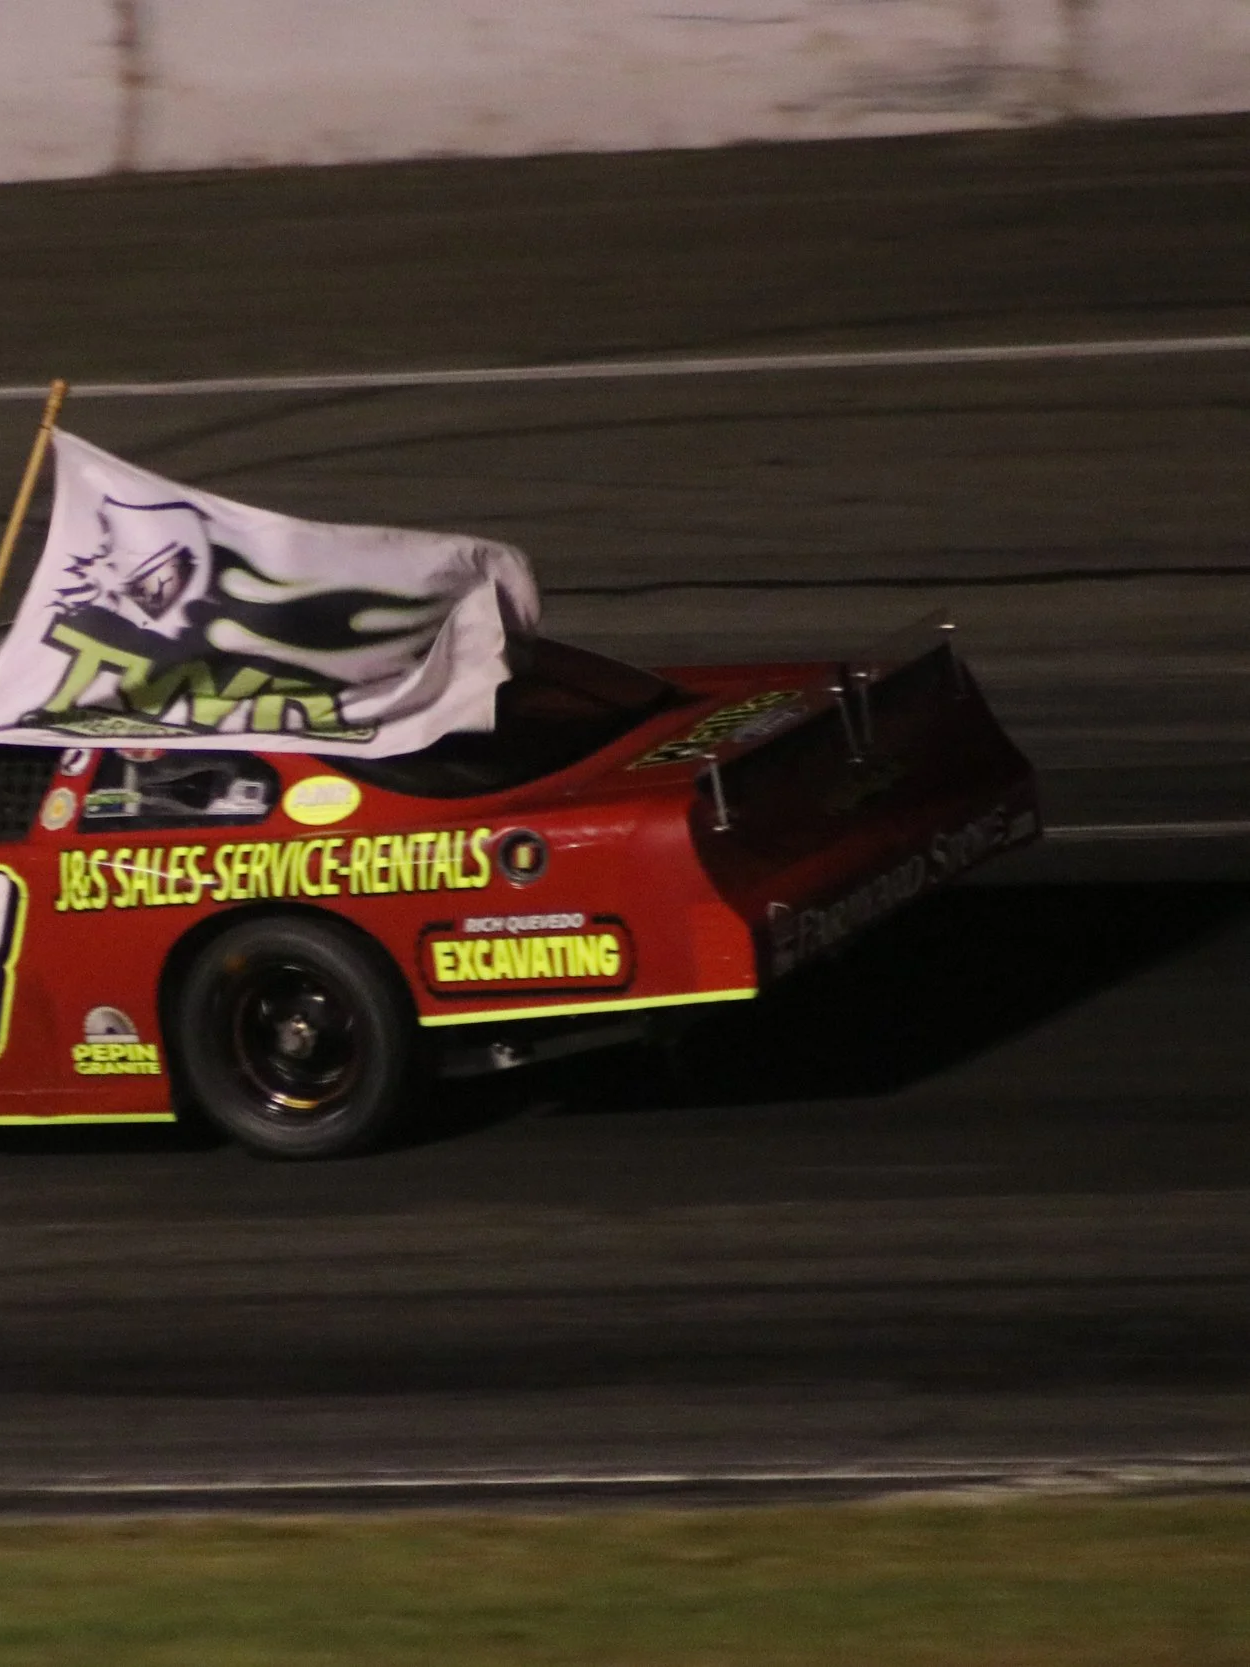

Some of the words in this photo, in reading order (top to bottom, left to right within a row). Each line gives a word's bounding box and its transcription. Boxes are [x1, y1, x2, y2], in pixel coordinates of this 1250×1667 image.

[55, 849, 109, 912] J&S
[112, 828, 492, 906] SALES-SERVICE-RENTALS
[463, 918, 503, 933] RICH
[506, 913, 585, 934] QUEVEDO
[431, 934, 621, 982] EXCAVATING
[73, 1044, 158, 1061] PEPIN
